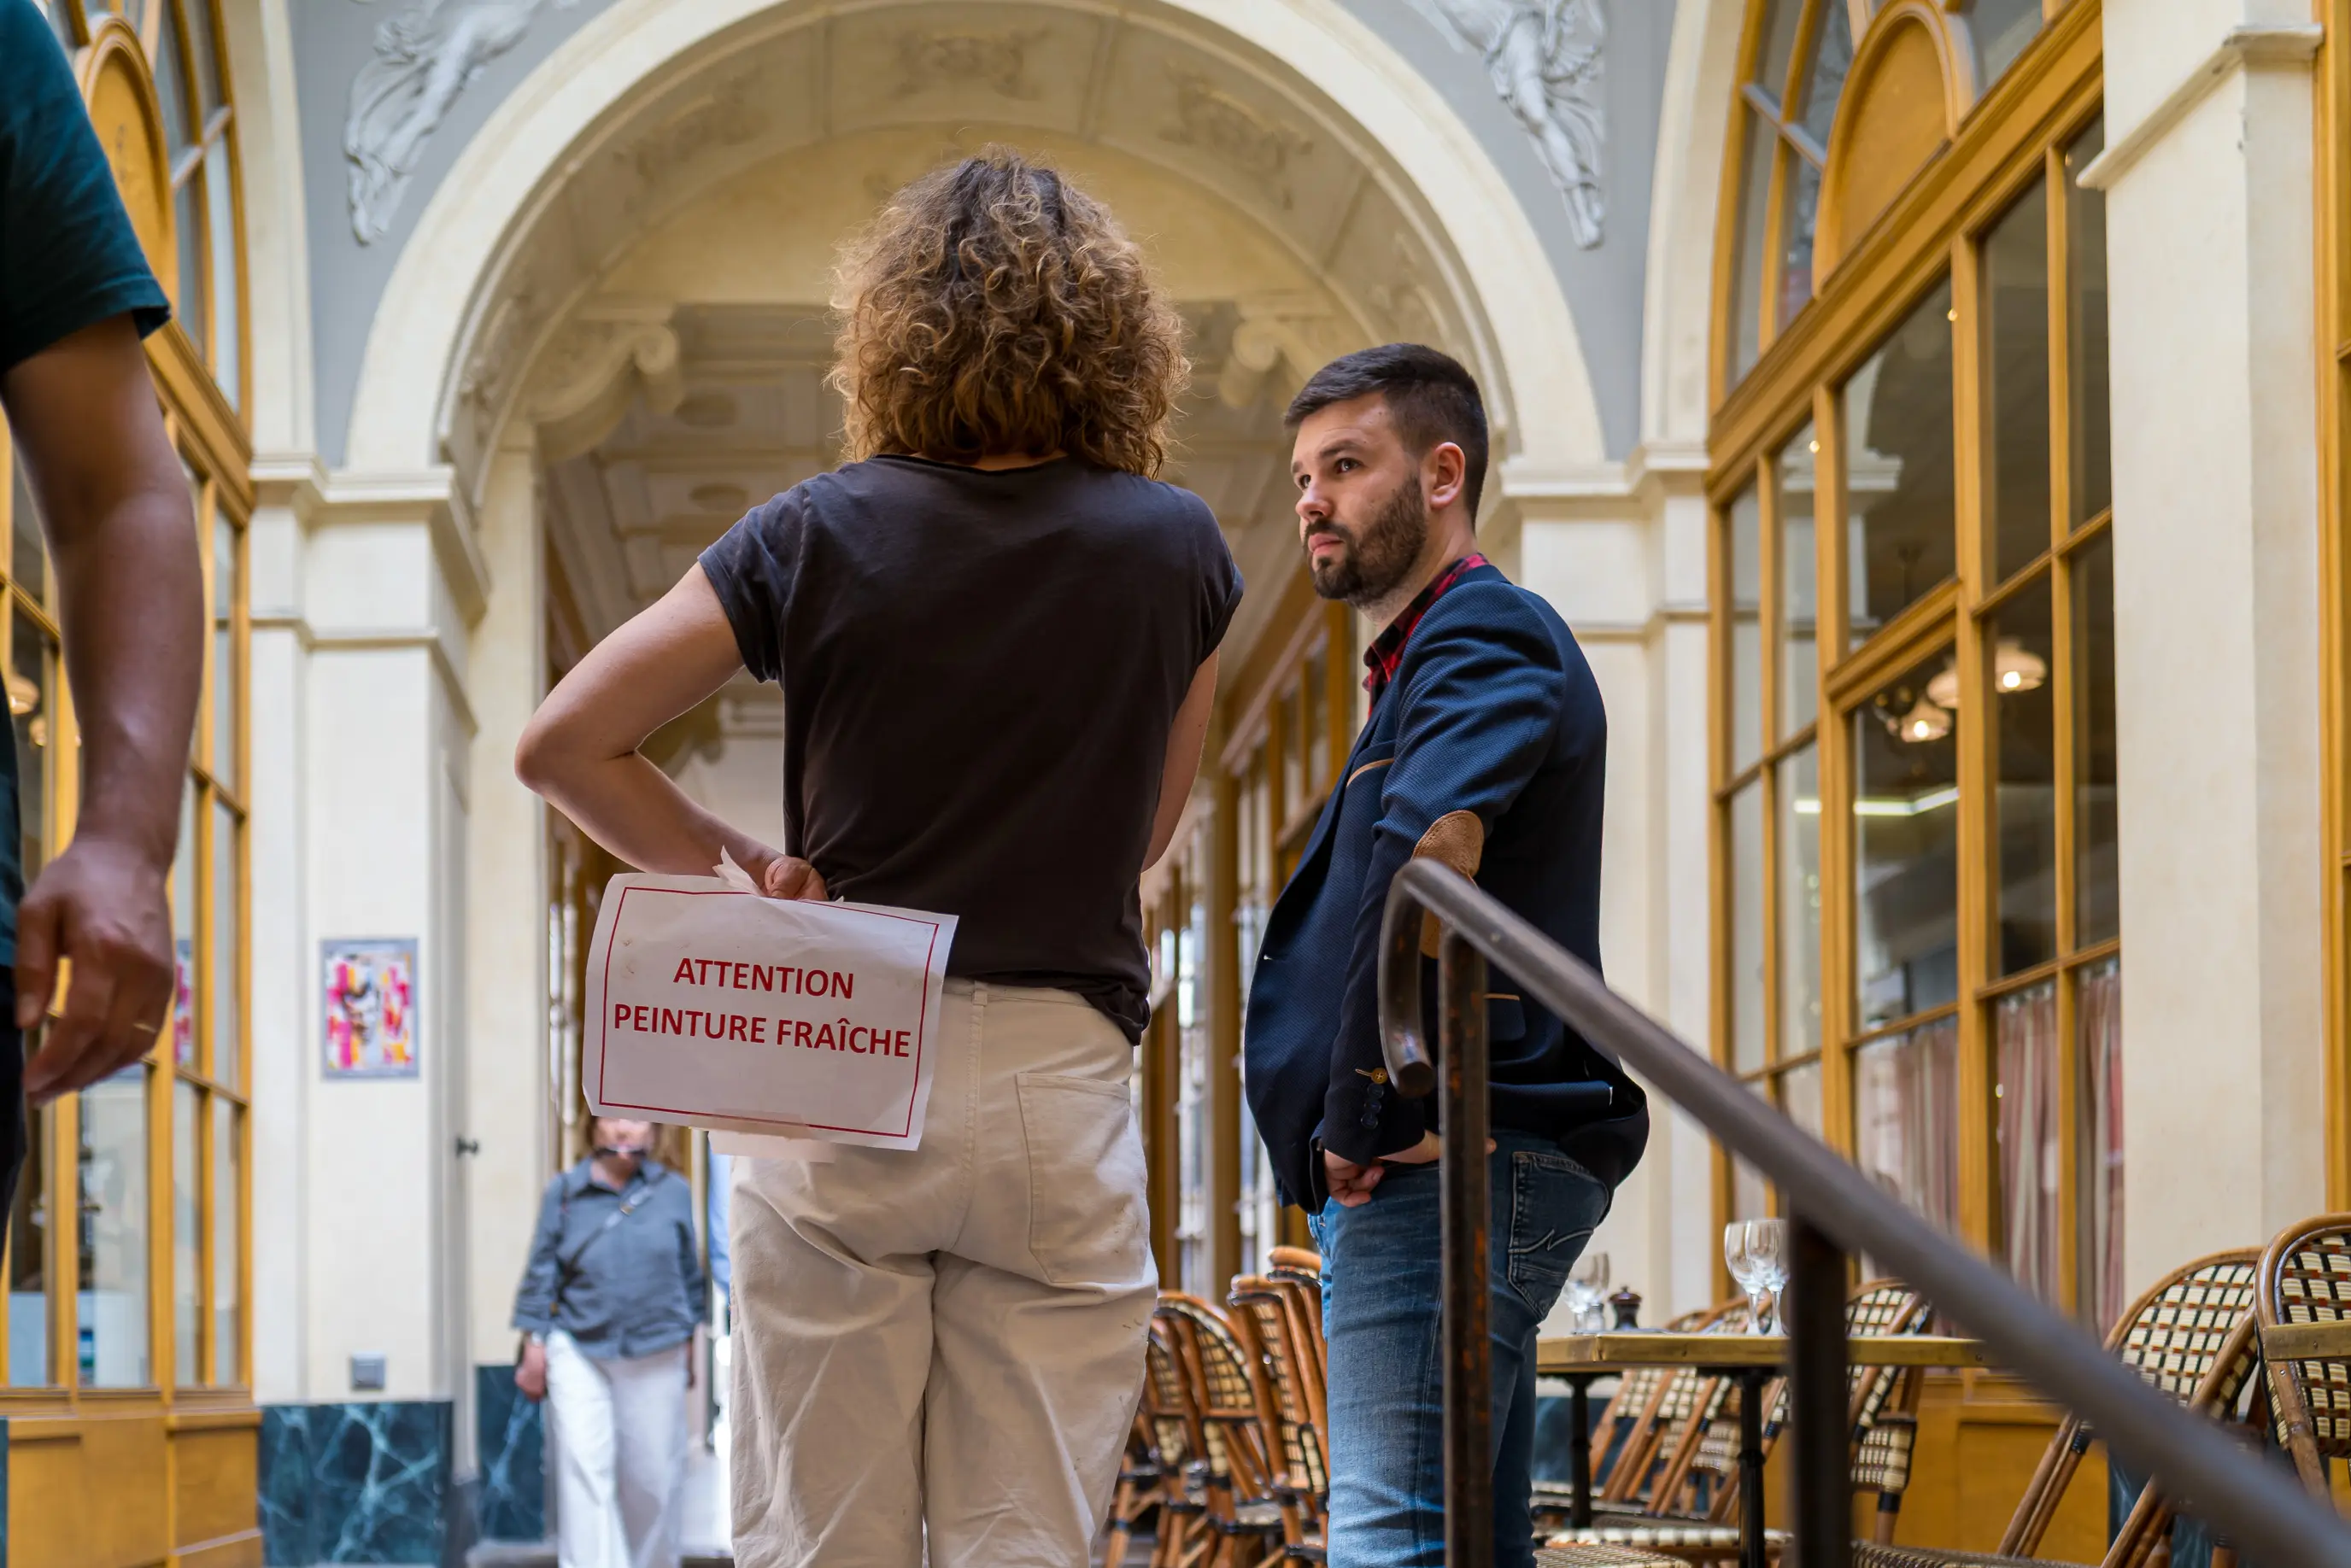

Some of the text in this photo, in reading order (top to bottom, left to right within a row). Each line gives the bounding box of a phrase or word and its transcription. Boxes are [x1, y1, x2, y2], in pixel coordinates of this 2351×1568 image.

[673, 957, 854, 1000] ATTENTION
[614, 1003, 912, 1058] PEINTURE FRAÎCHE
